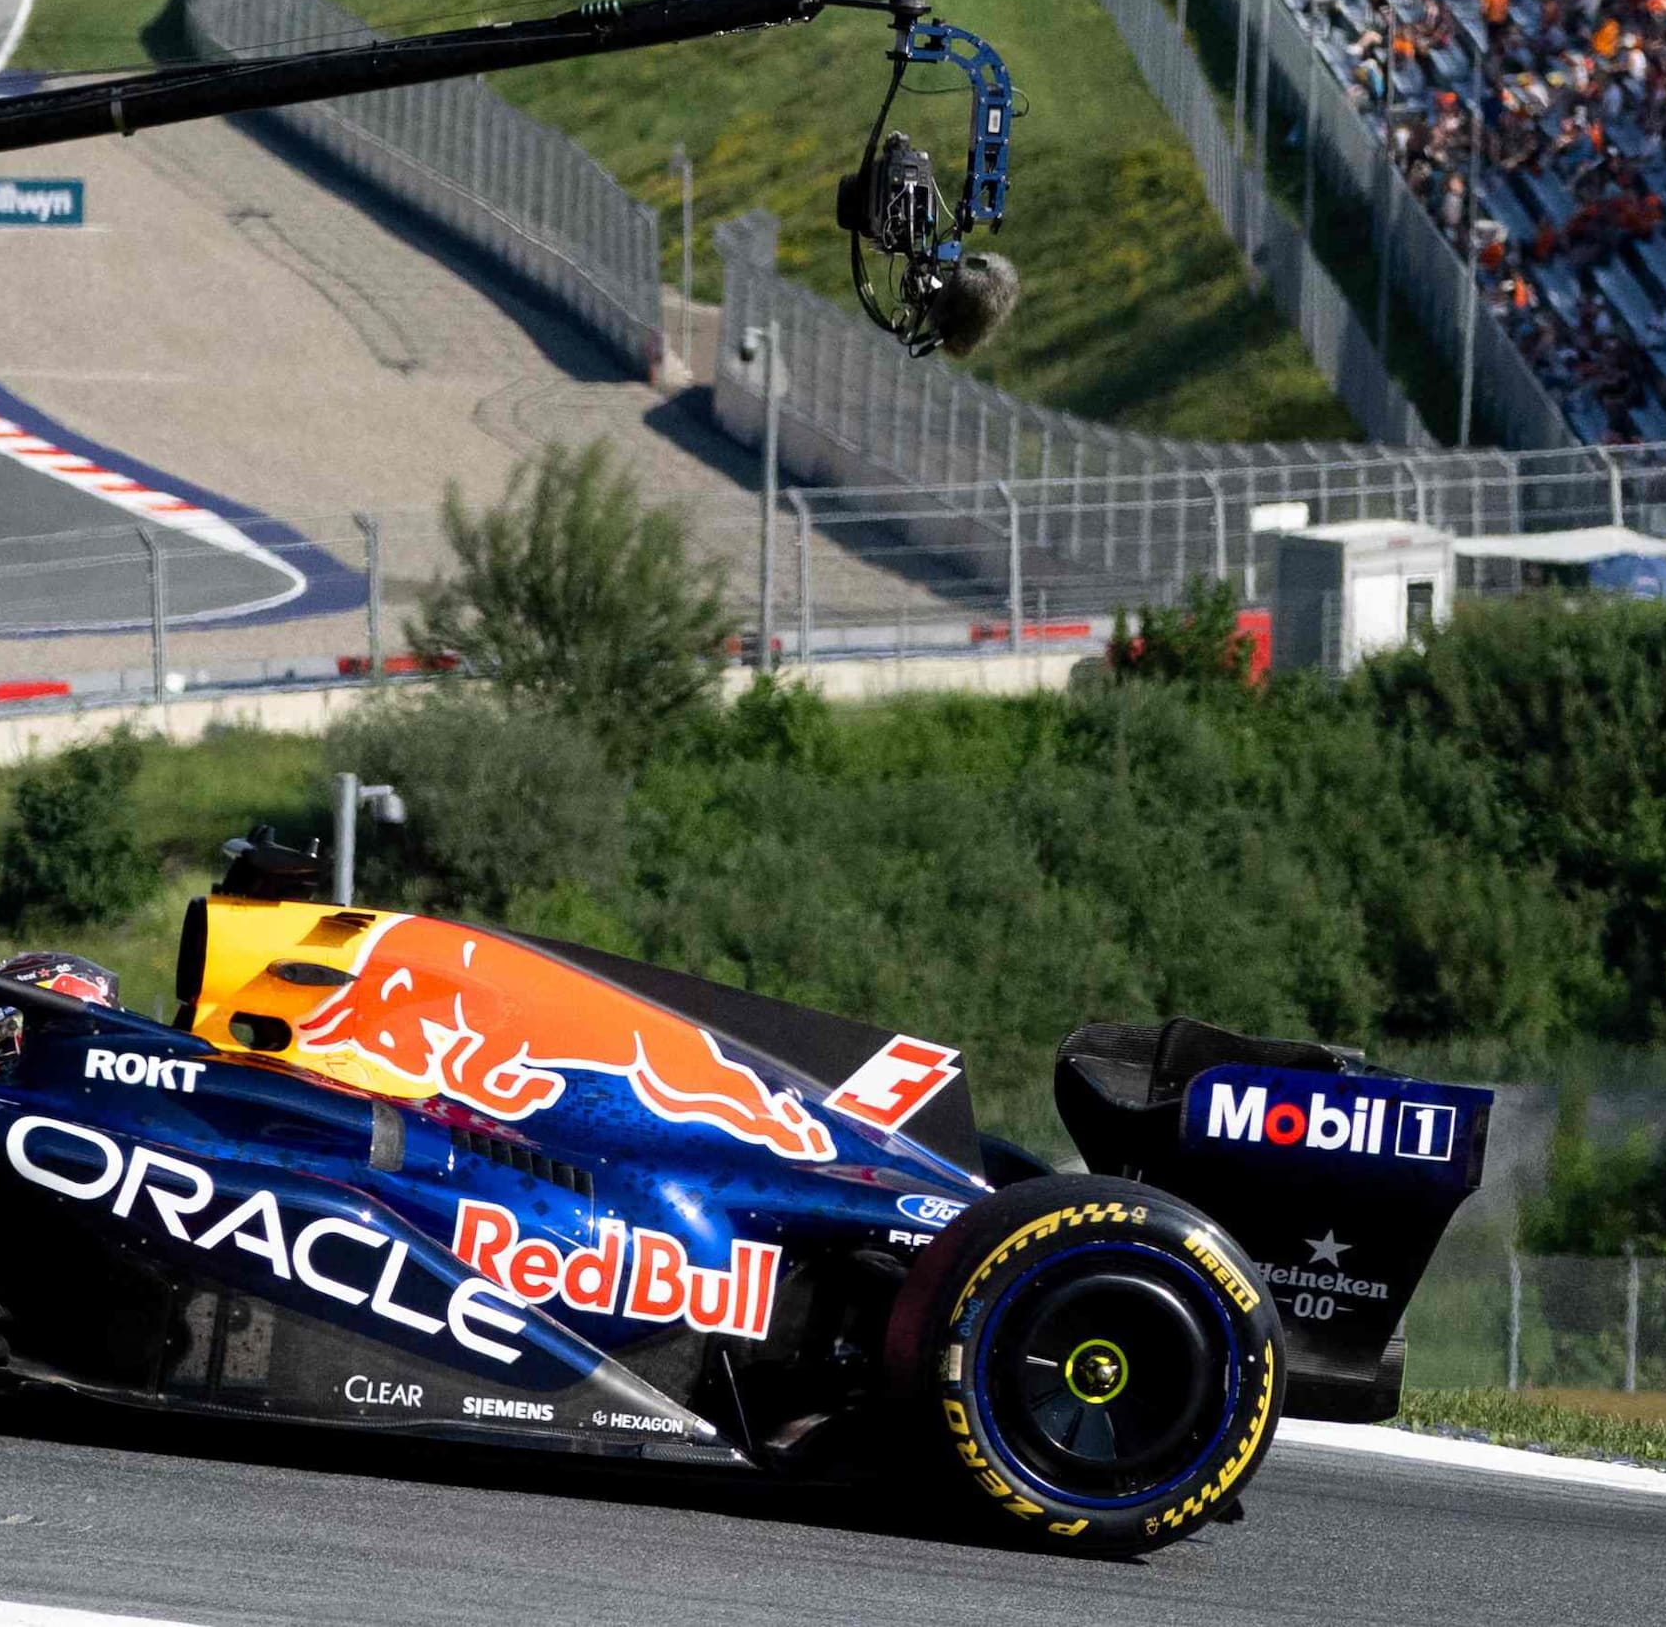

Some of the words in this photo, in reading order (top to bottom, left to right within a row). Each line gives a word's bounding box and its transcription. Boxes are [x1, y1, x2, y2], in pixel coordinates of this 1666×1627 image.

[84, 1048, 206, 1093] ROKT
[1206, 1083, 1387, 1155] Mobil
[5, 1116, 528, 1364] ORACLE
[451, 1199, 624, 1315] Red
[625, 1227, 783, 1341] Bull
[1183, 1227, 1261, 1314] PIRELLI
[1254, 1261, 1389, 1300] Heineken
[344, 1375, 423, 1408] CLEAR
[462, 1396, 554, 1421] SIEMENS
[610, 1412, 684, 1433] HEXAGON
[942, 1398, 1045, 1521] ZERO
